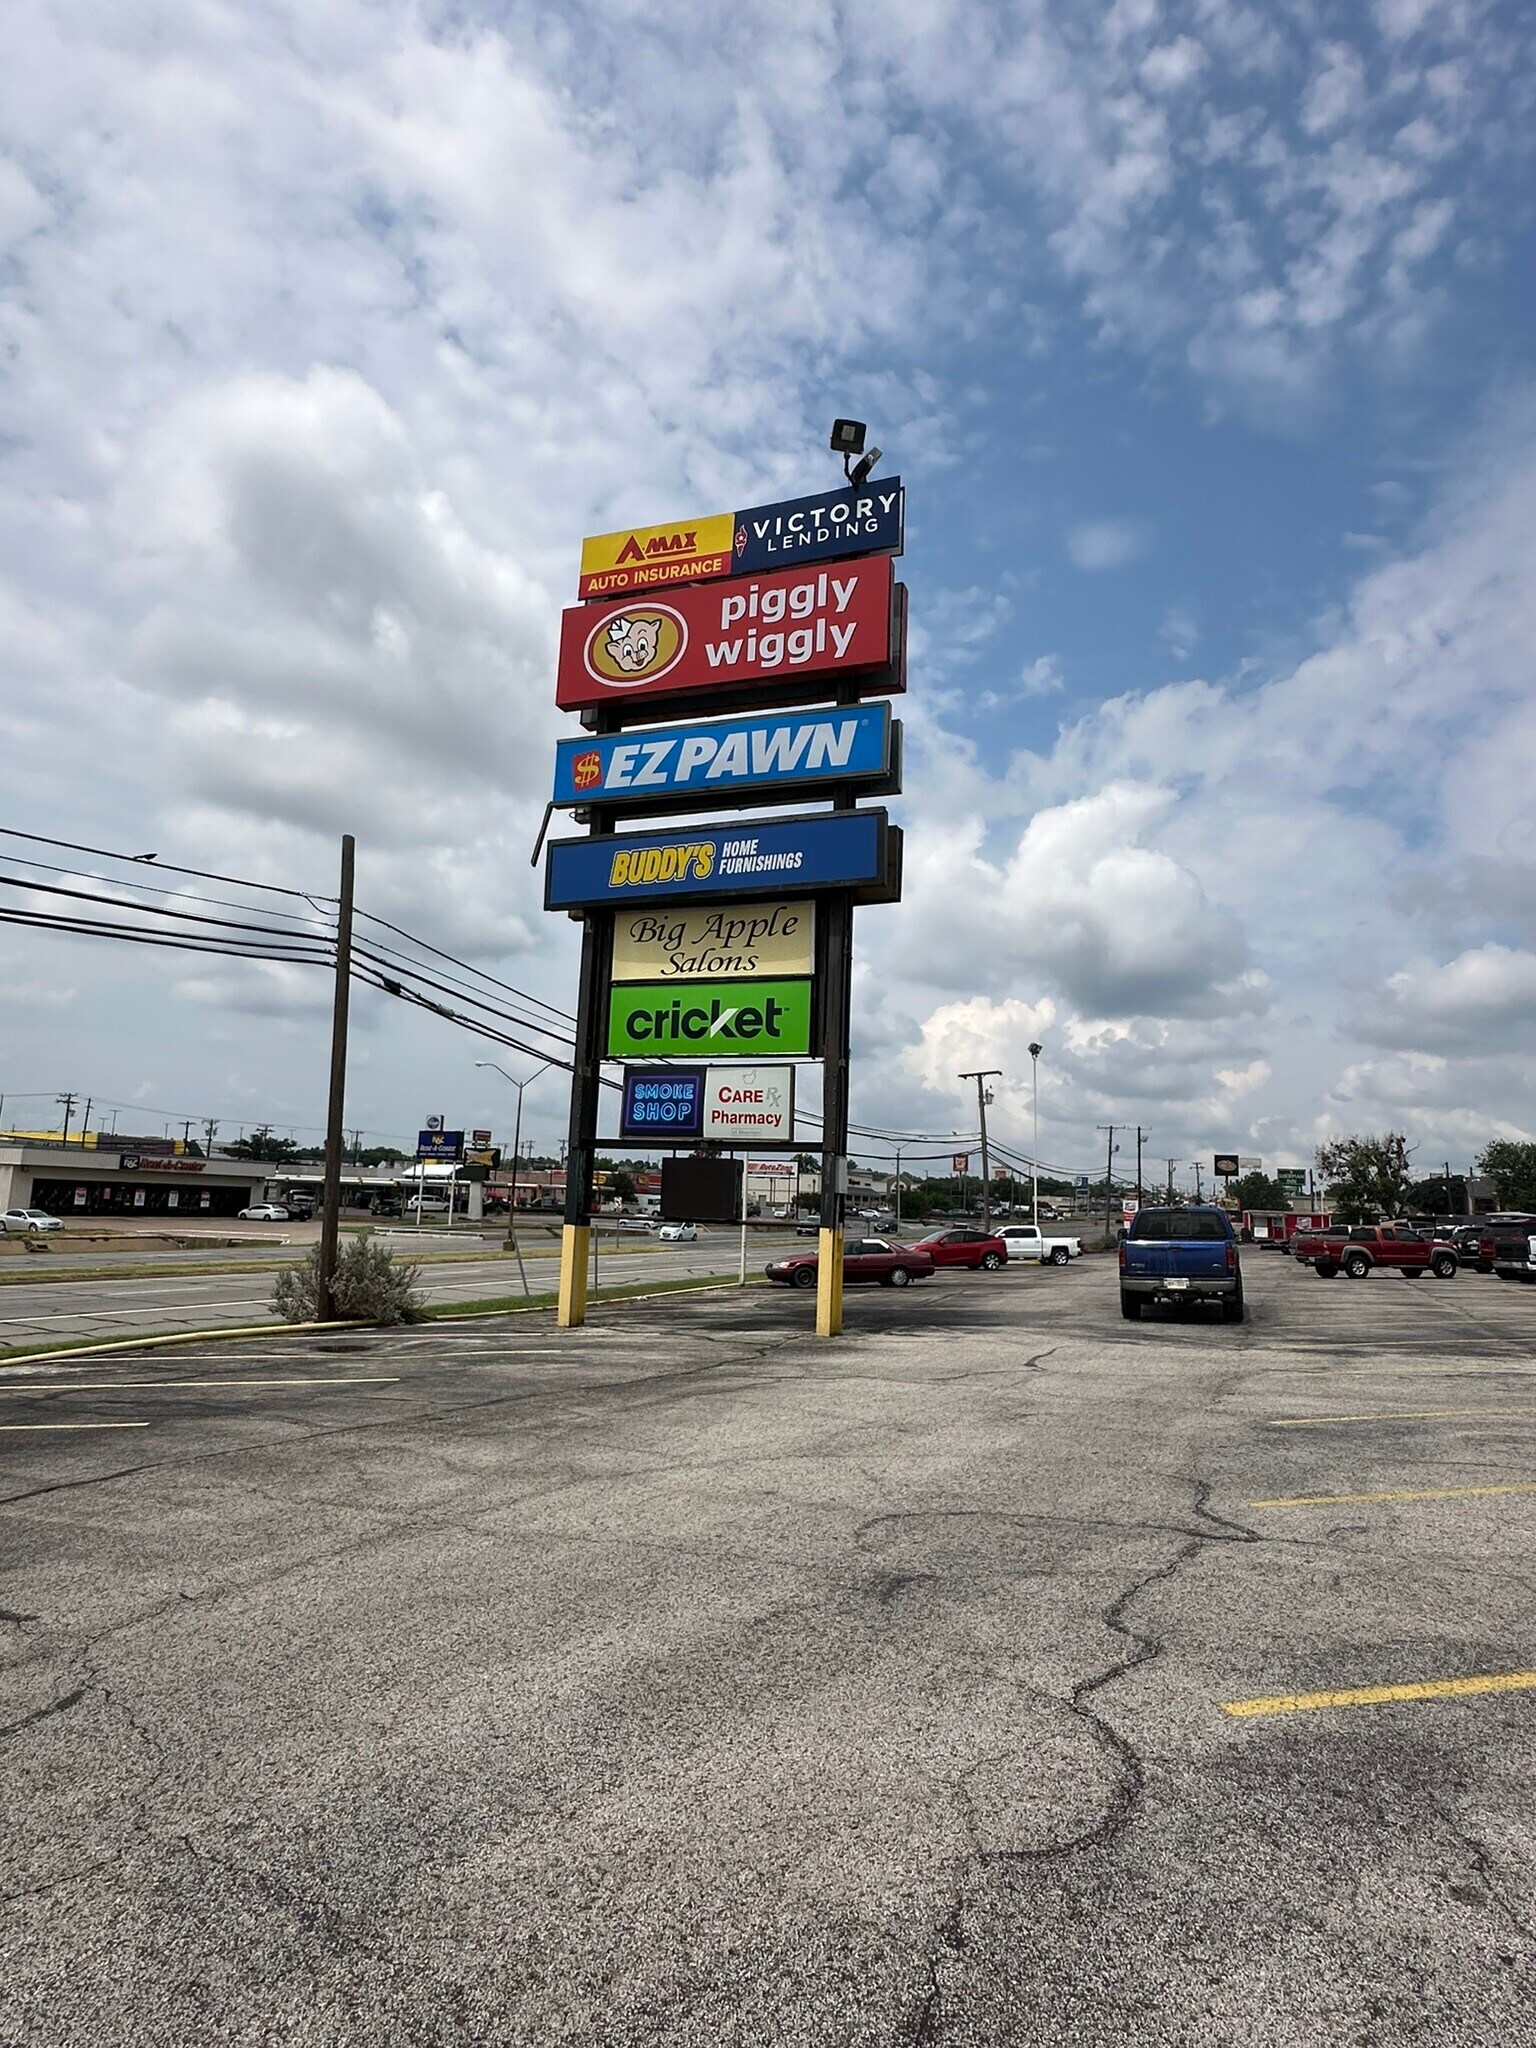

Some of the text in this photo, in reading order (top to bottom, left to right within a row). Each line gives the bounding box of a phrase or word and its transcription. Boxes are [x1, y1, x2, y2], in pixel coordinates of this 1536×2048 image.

[753, 491, 897, 540] VICTORY
[615, 530, 697, 564] A-MAX
[767, 518, 879, 552] LENDING
[588, 558, 722, 592] AUTO INSURANCE
[721, 573, 860, 630] piggly
[705, 617, 858, 669] wiggly
[609, 841, 716, 888] BUDDY'S
[718, 851, 803, 875] FURNISHINGS
[722, 839, 759, 856] HOME
[630, 905, 799, 951] Big Apple
[660, 947, 759, 976] Salons
[626, 997, 784, 1040] cricket
[635, 1083, 695, 1100] SMOKE
[718, 1086, 763, 1104] CARE
[633, 1103, 692, 1121] SHOP
[711, 1110, 782, 1127] Pharmacy
